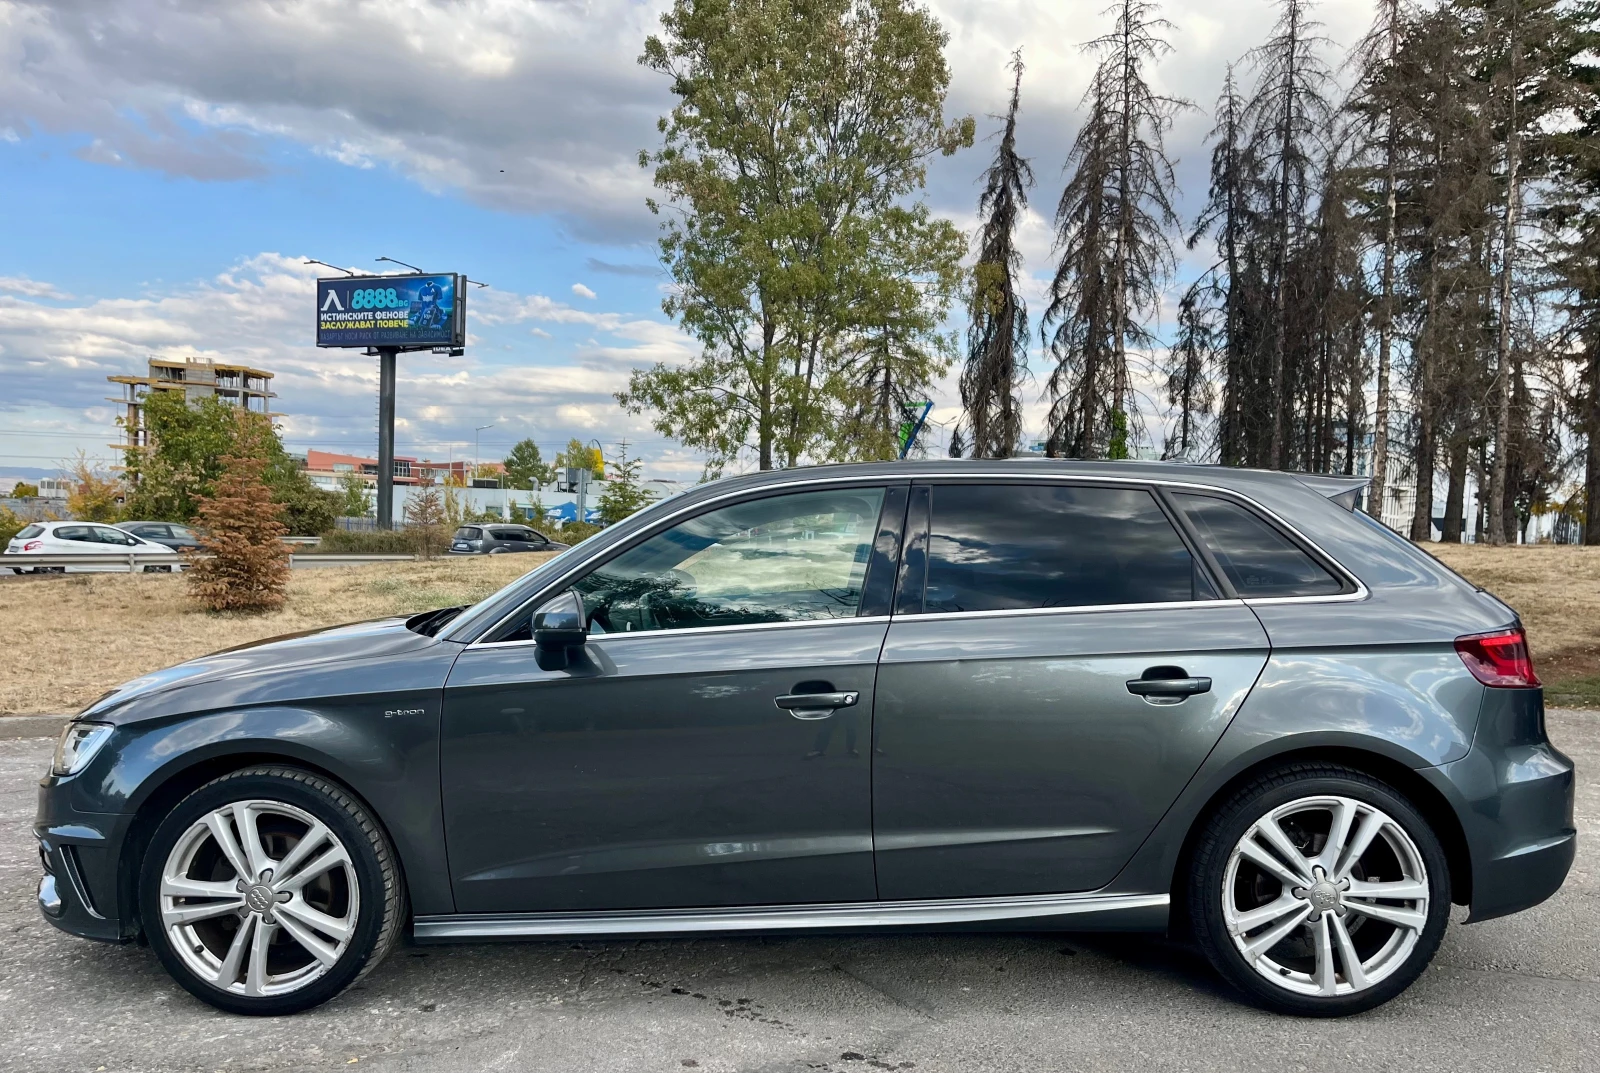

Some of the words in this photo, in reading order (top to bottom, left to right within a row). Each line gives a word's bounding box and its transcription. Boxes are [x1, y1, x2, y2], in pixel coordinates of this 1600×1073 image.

[320, 311, 373, 321] ИСТИНСКИТЕ
[375, 310, 409, 320] ФЕНОВЕ
[320, 320, 375, 330] ЗАСЛУЖАВАТ
[377, 319, 409, 328] ПОВЕЧЕ
[345, 332, 358, 340] НОСИ
[359, 331, 372, 340] РИСК
[373, 331, 380, 340] ОТ
[380, 330, 408, 339] РАЗВИВАНЕ
[409, 330, 417, 339] НА
[384, 709, 425, 718] g-tron
